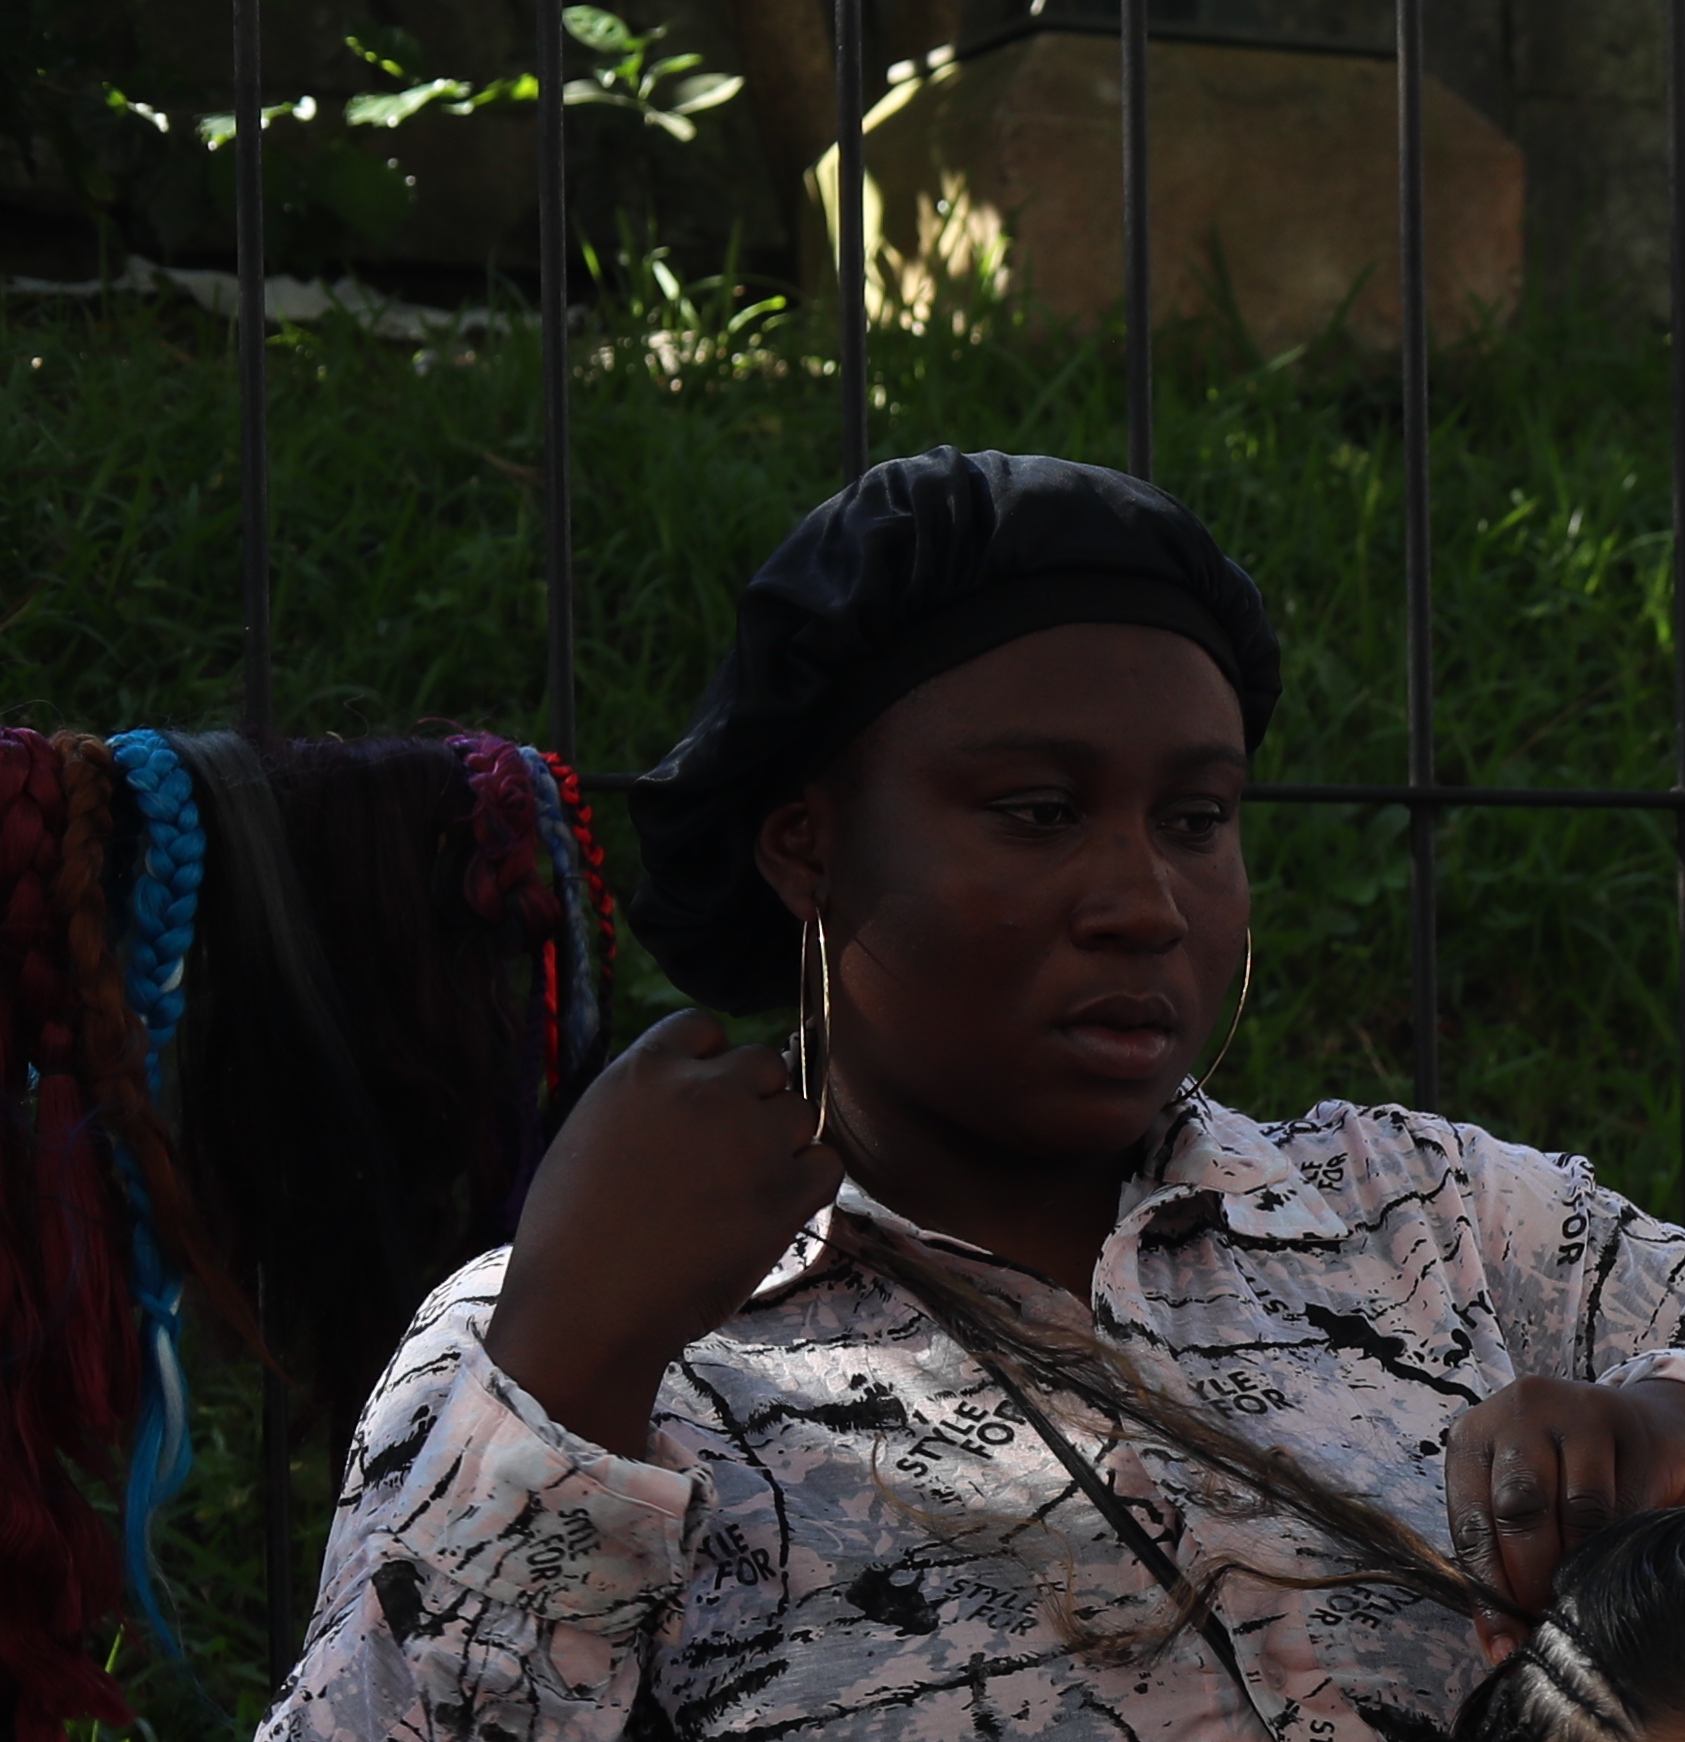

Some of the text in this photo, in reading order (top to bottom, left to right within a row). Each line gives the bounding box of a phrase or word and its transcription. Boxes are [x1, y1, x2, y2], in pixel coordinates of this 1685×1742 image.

[896, 1400, 989, 1478] STYLE
[713, 1553, 776, 1591] FOR
[945, 1577, 1038, 1615] STYLE
